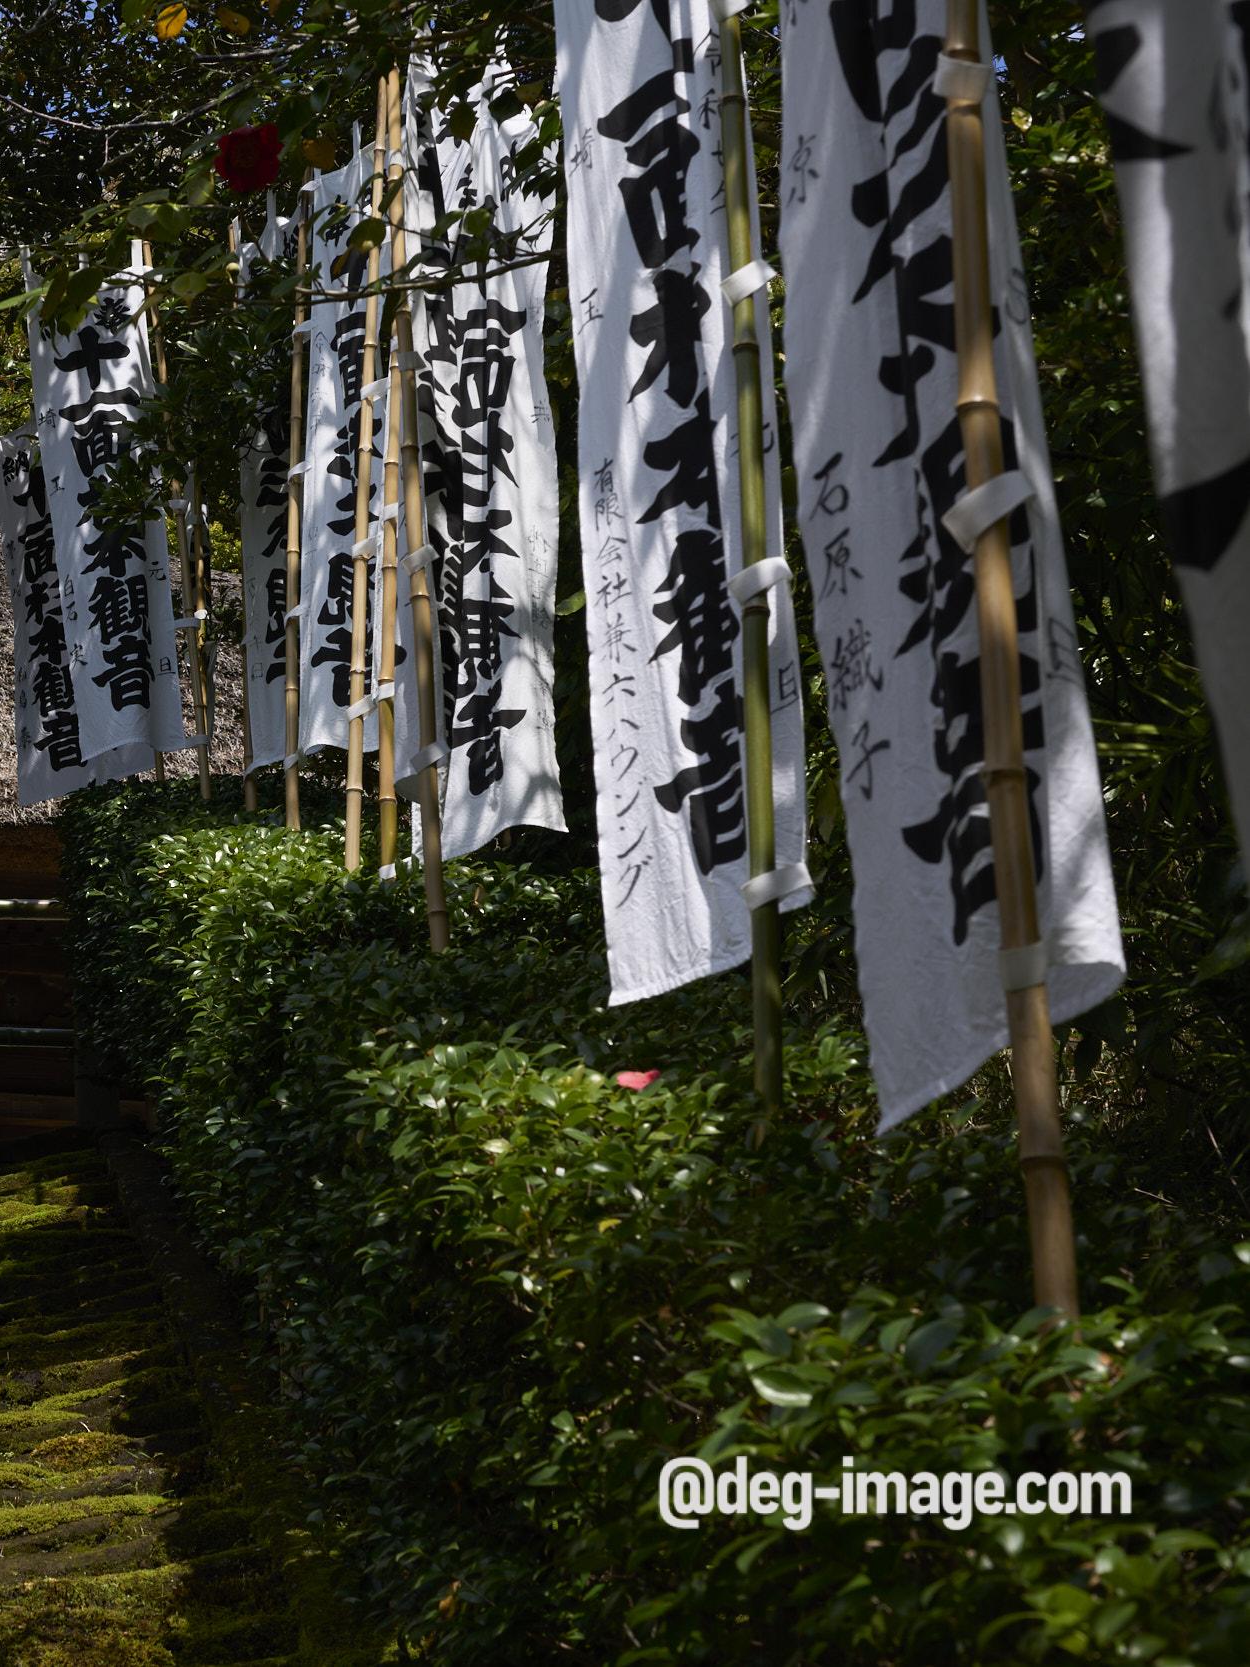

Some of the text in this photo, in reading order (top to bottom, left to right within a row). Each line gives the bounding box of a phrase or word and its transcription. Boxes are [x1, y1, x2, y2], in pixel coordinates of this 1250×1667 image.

[53, 325, 155, 712] 十一面本観音
